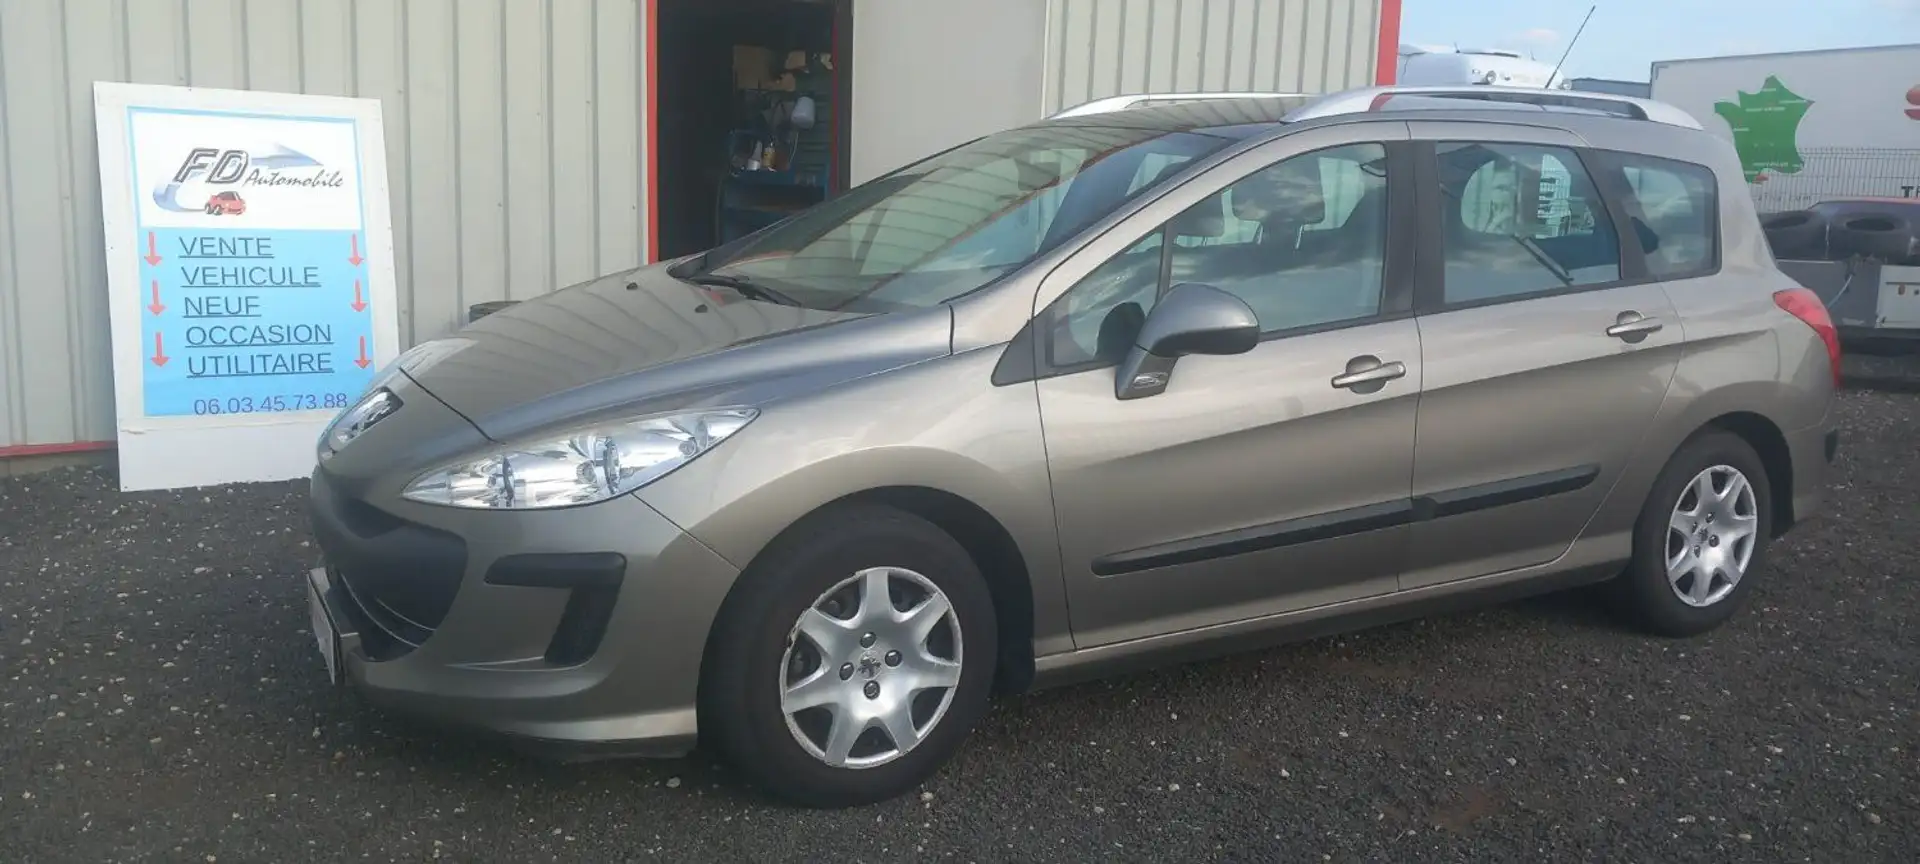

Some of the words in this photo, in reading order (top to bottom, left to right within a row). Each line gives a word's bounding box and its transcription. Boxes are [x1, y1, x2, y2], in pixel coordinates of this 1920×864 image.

[175, 148, 249, 184] FD
[244, 169, 344, 188] Automobile
[179, 237, 274, 258] VENTE
[181, 266, 321, 288] VEHICULE
[184, 296, 261, 318] NEUF
[186, 325, 333, 347] OCCASION
[187, 353, 334, 378] UTILITAIRE
[194, 393, 348, 416] 06.03.45.73.88
